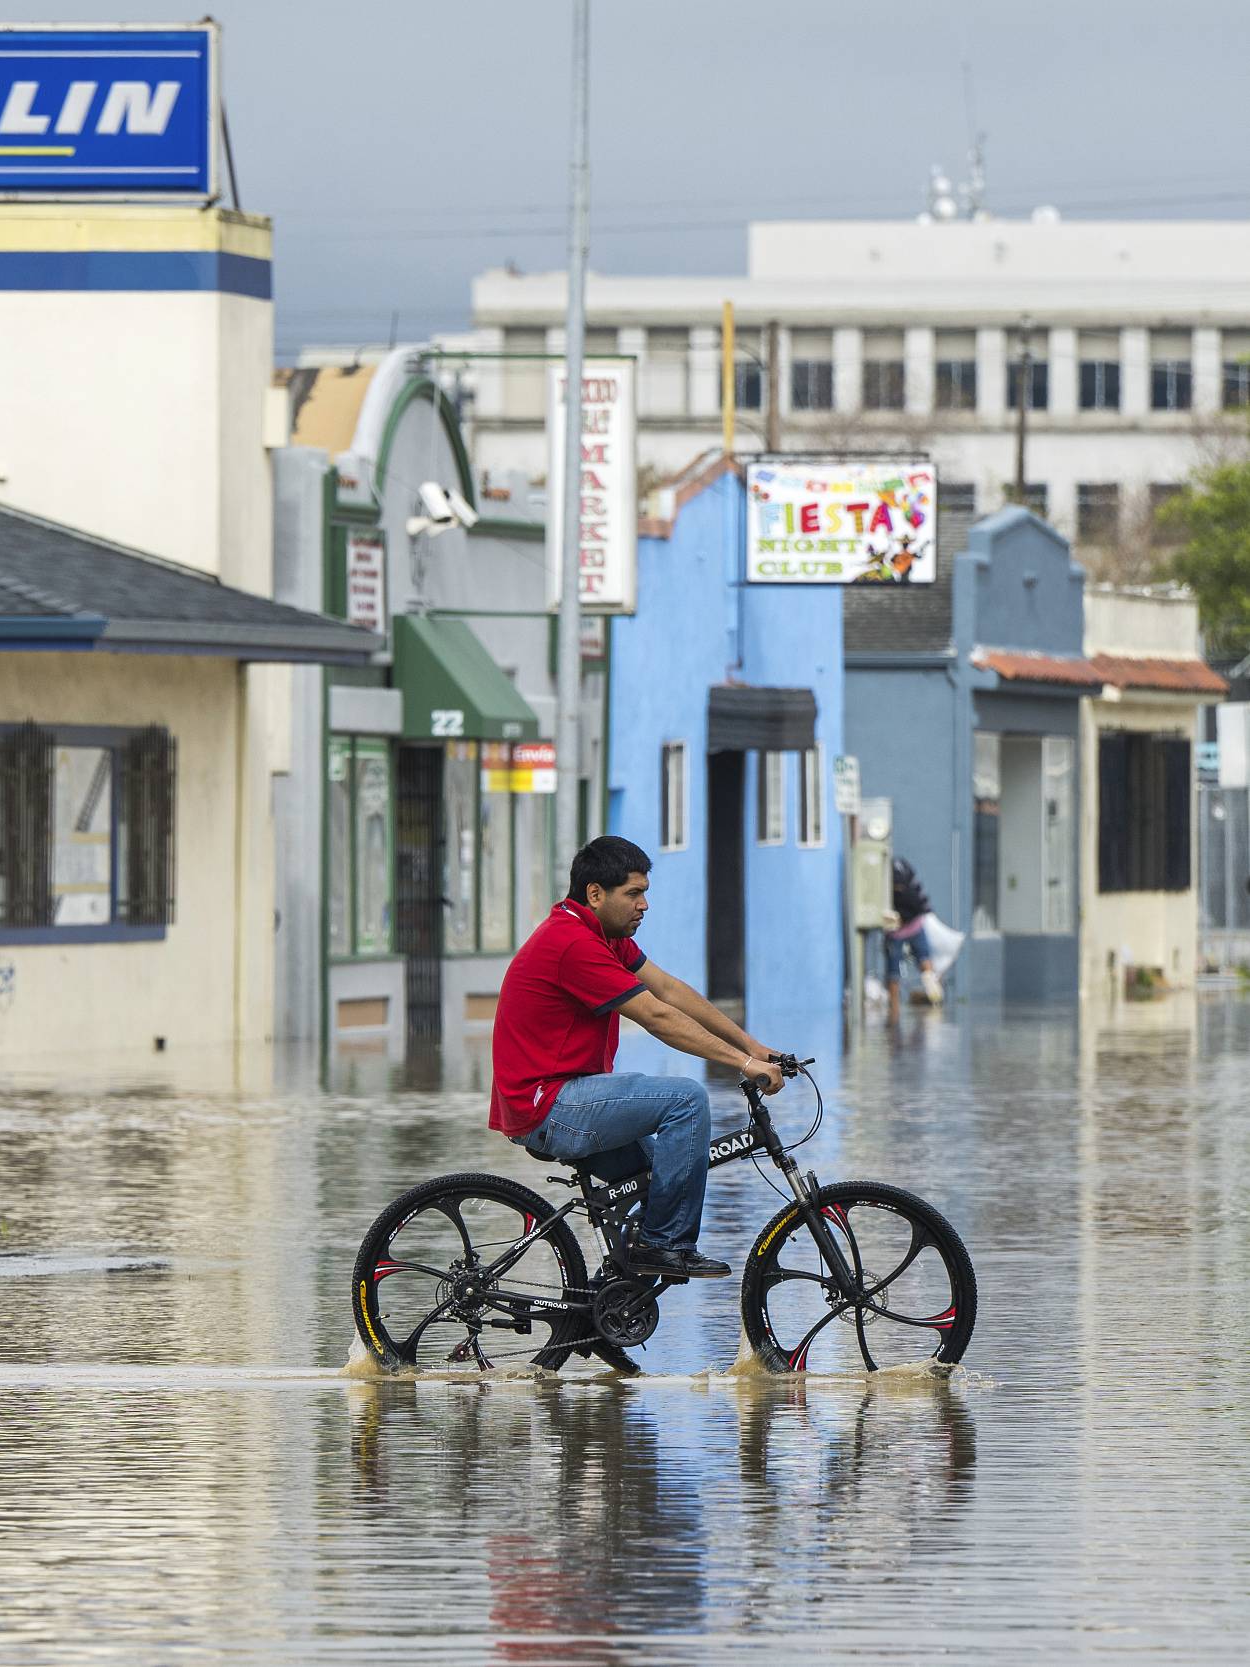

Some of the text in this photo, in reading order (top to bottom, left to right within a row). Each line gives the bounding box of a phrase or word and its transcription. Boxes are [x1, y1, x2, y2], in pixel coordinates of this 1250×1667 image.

[579, 443, 610, 594] MARKET
[759, 501, 894, 536] FIESTA
[757, 538, 863, 554] NIGHT
[756, 560, 844, 577] CLUB
[430, 709, 465, 737] 22
[709, 1133, 754, 1162] ROAD
[608, 1180, 638, 1200] R-100
[514, 1228, 541, 1250] OUTROAD
[533, 1299, 568, 1310] OUTROAD
